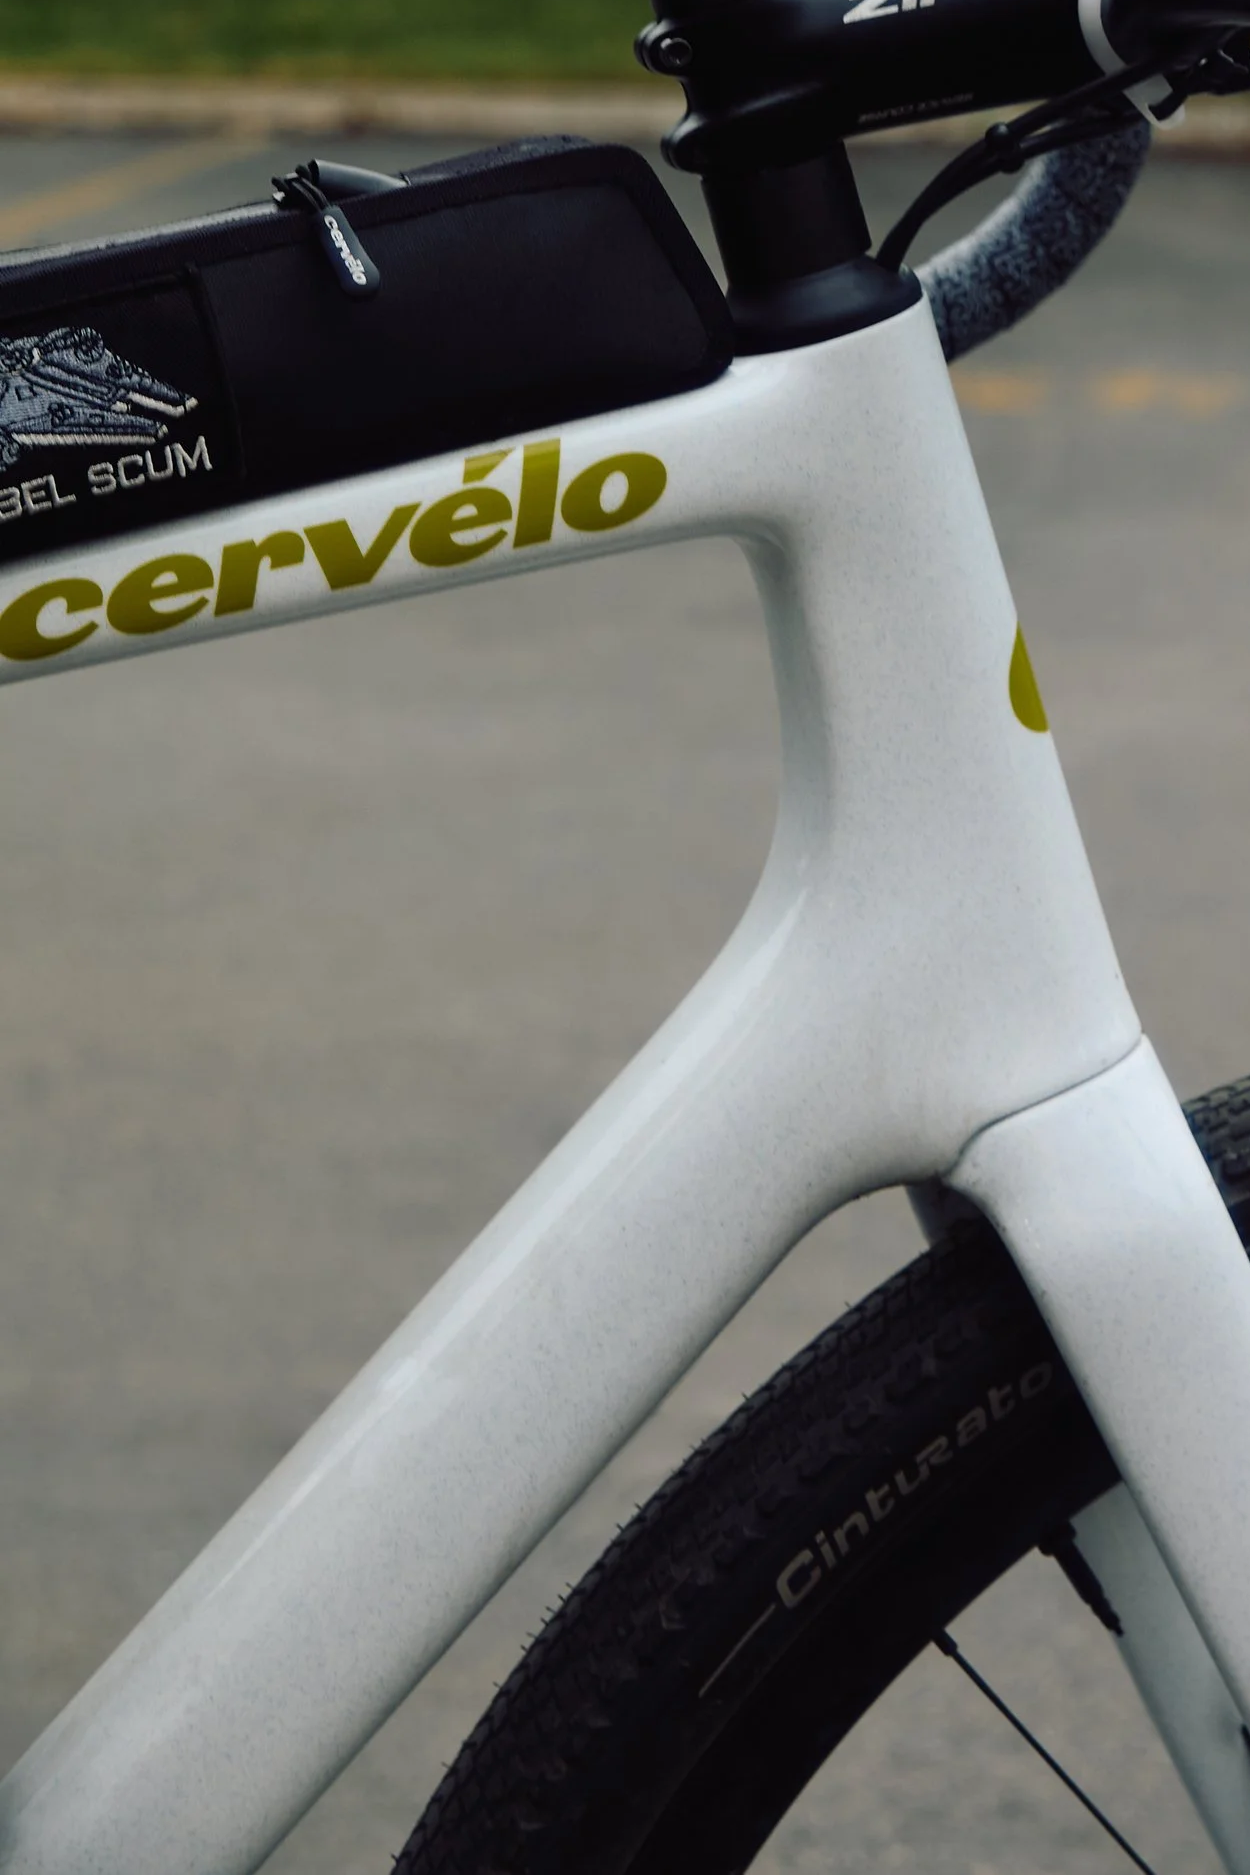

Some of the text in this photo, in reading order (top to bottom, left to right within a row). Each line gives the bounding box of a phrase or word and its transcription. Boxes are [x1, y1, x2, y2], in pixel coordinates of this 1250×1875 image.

[0, 438, 668, 661] cervélo
[87, 434, 214, 497] SCUM
[775, 1360, 1055, 1611] Cinturato
